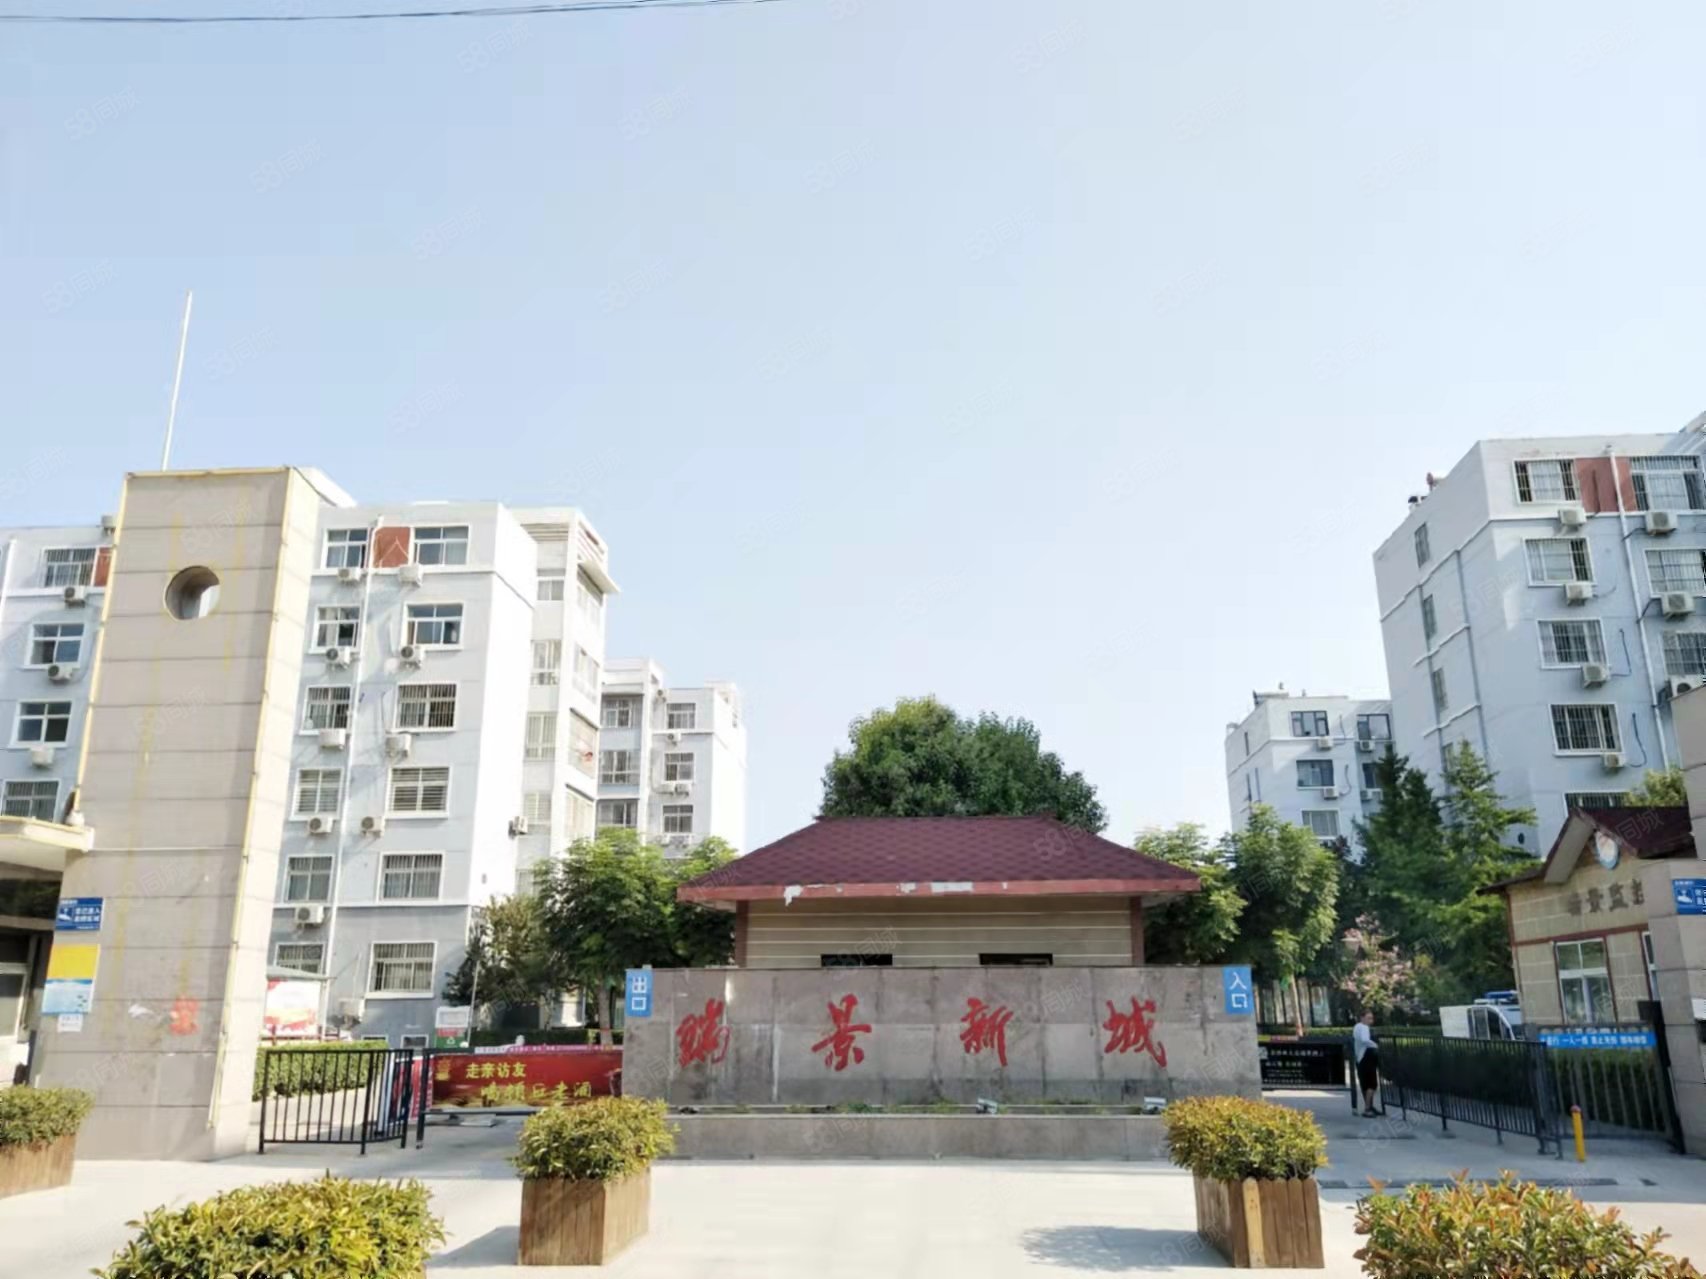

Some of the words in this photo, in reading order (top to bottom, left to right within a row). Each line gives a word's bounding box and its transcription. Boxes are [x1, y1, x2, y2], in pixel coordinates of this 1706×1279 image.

[631, 976, 647, 1011] 出口
[1229, 972, 1248, 1009] 入口
[676, 993, 1167, 1072] 瑞景新城
